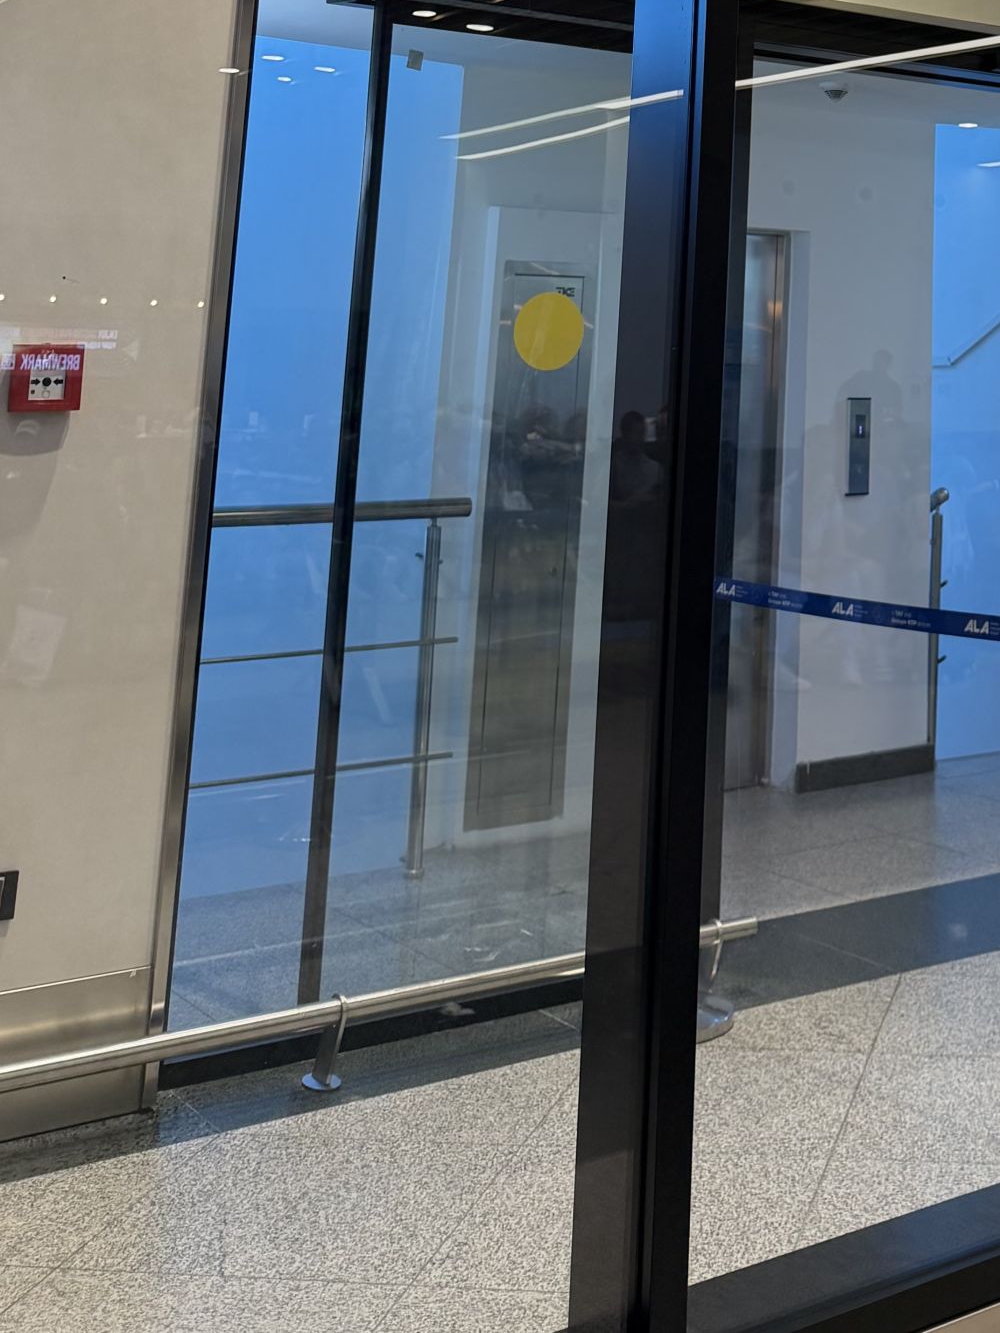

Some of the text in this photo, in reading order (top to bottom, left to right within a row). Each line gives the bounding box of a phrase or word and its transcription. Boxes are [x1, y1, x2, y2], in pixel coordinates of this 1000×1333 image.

[716, 582, 736, 596] ALA
[831, 602, 854, 617] ALA
[963, 619, 989, 635] ALA
